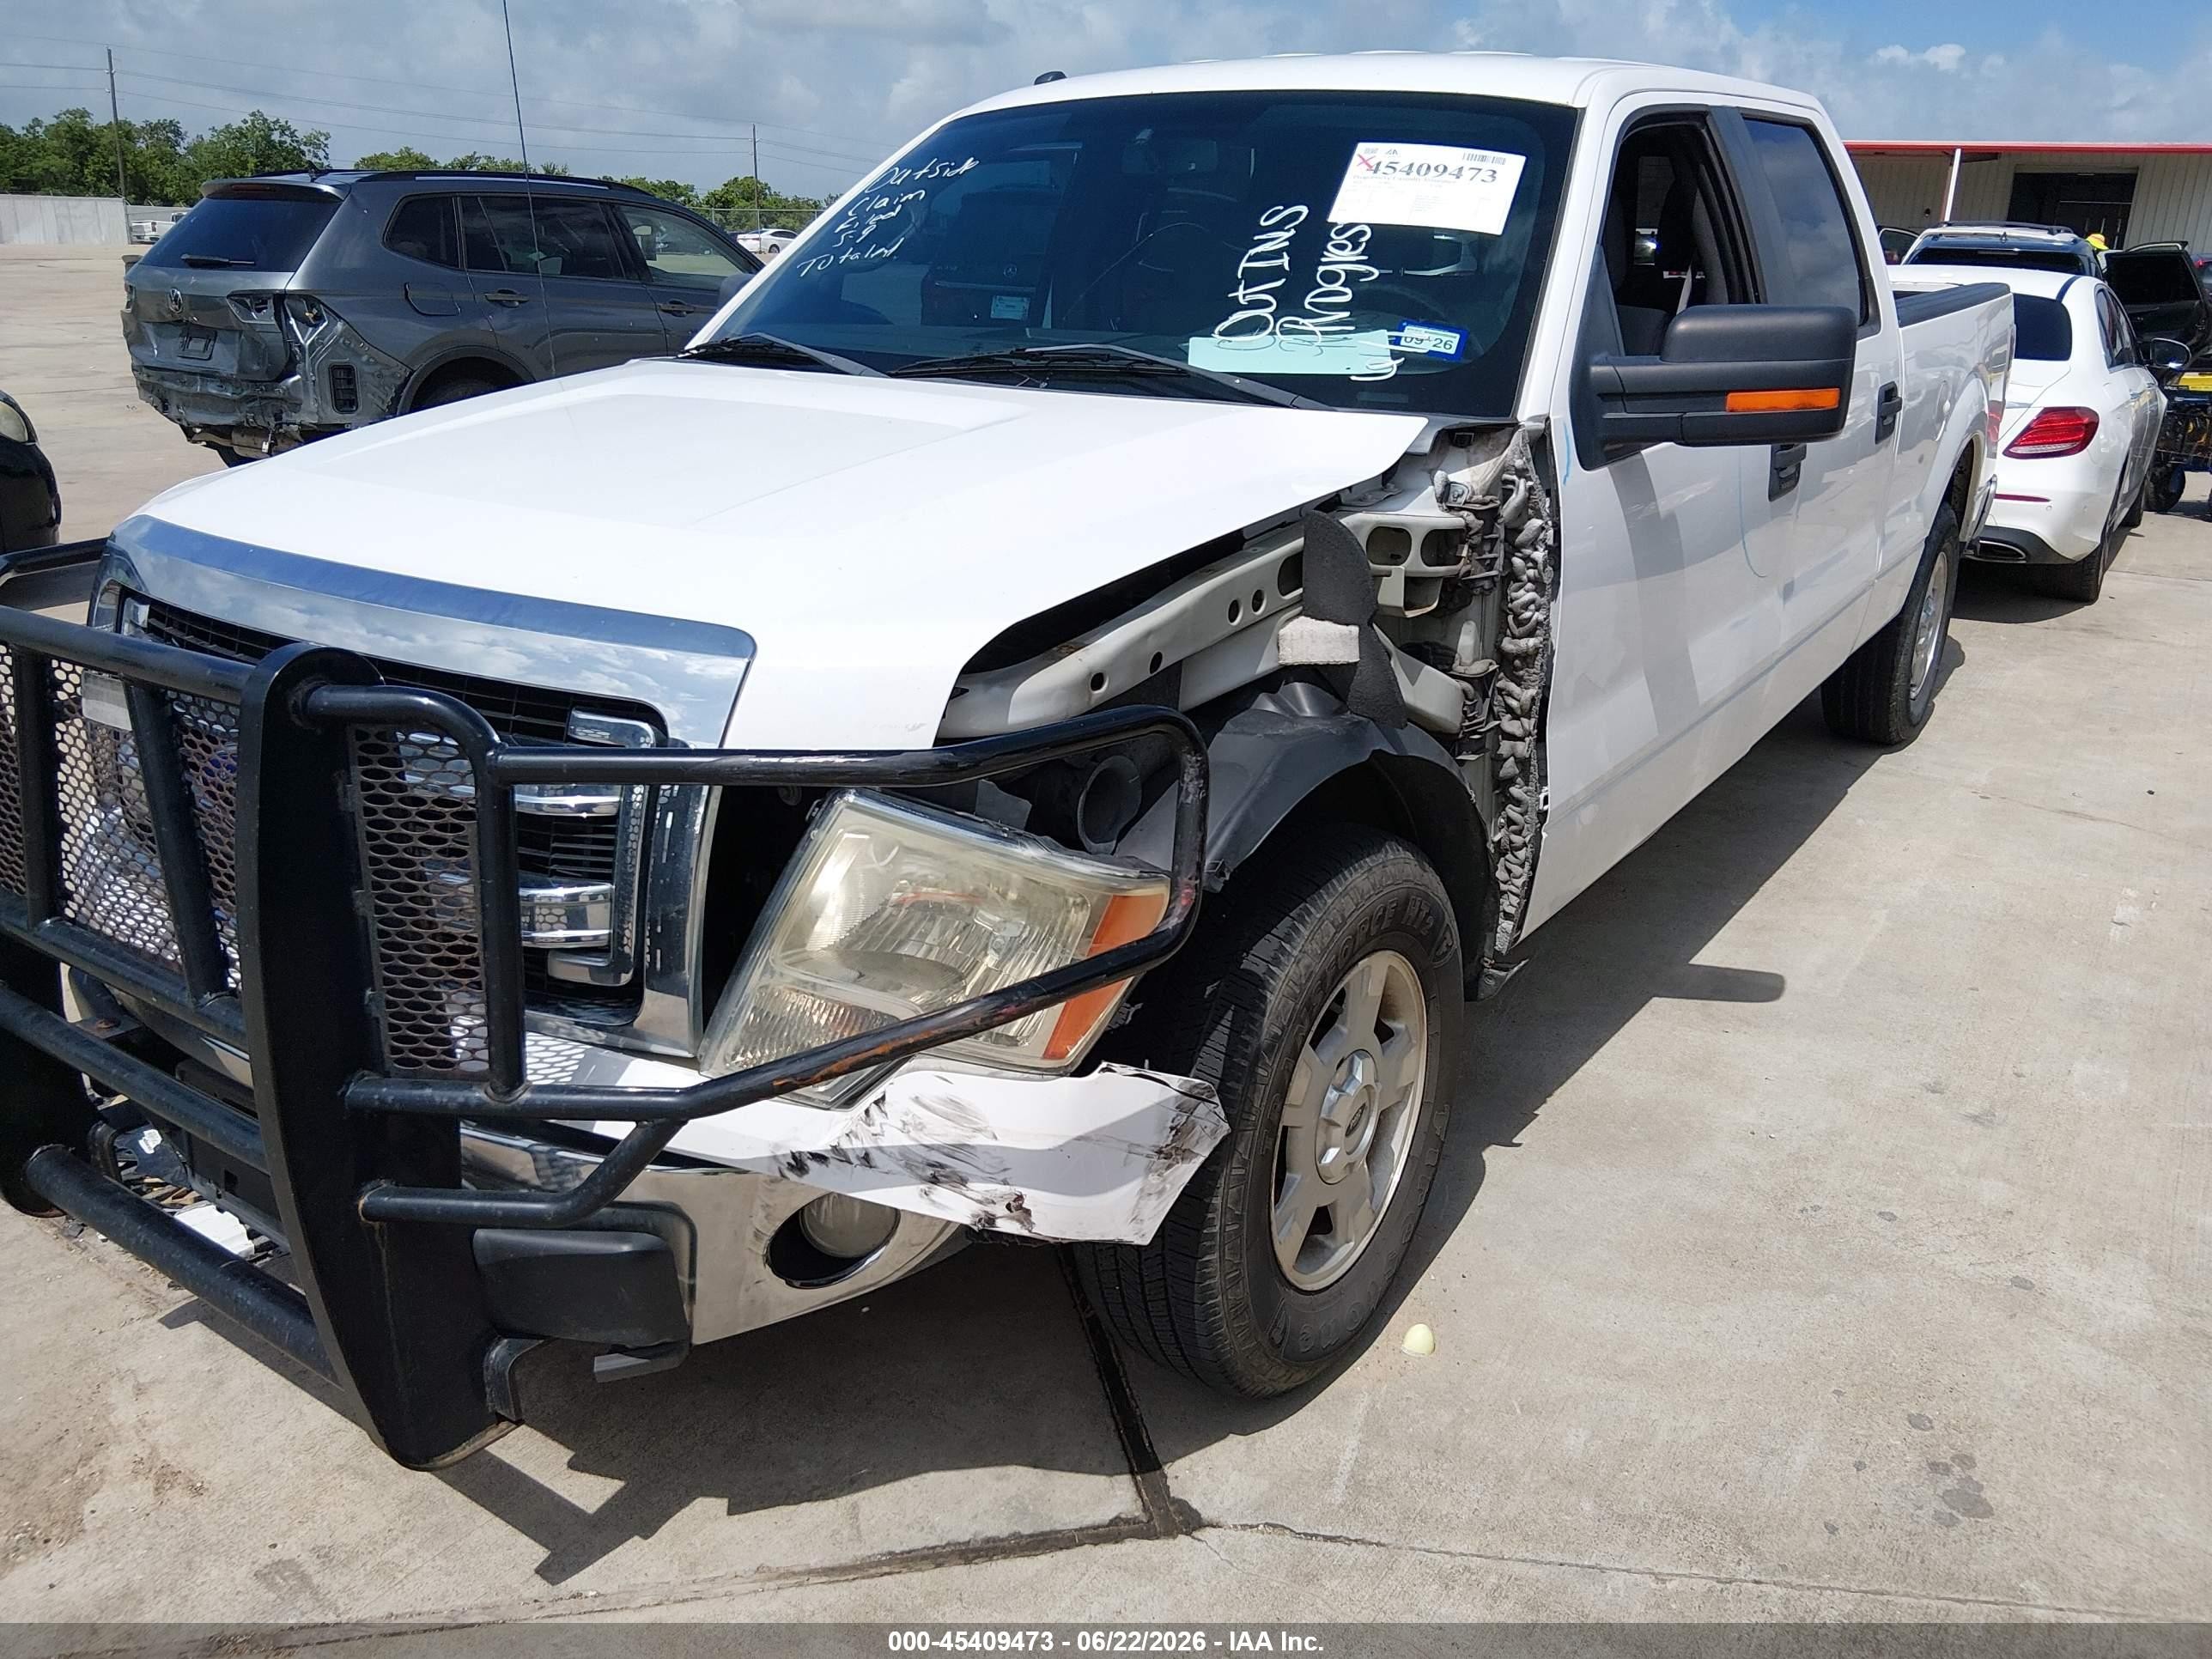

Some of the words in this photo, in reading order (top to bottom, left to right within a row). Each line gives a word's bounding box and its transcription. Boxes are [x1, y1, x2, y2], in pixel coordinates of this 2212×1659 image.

[1366, 159, 1498, 184] 45409473
[848, 189, 926, 216] Claim
[1432, 337, 1453, 350] 26
[1401, 896, 1436, 937] HT2
